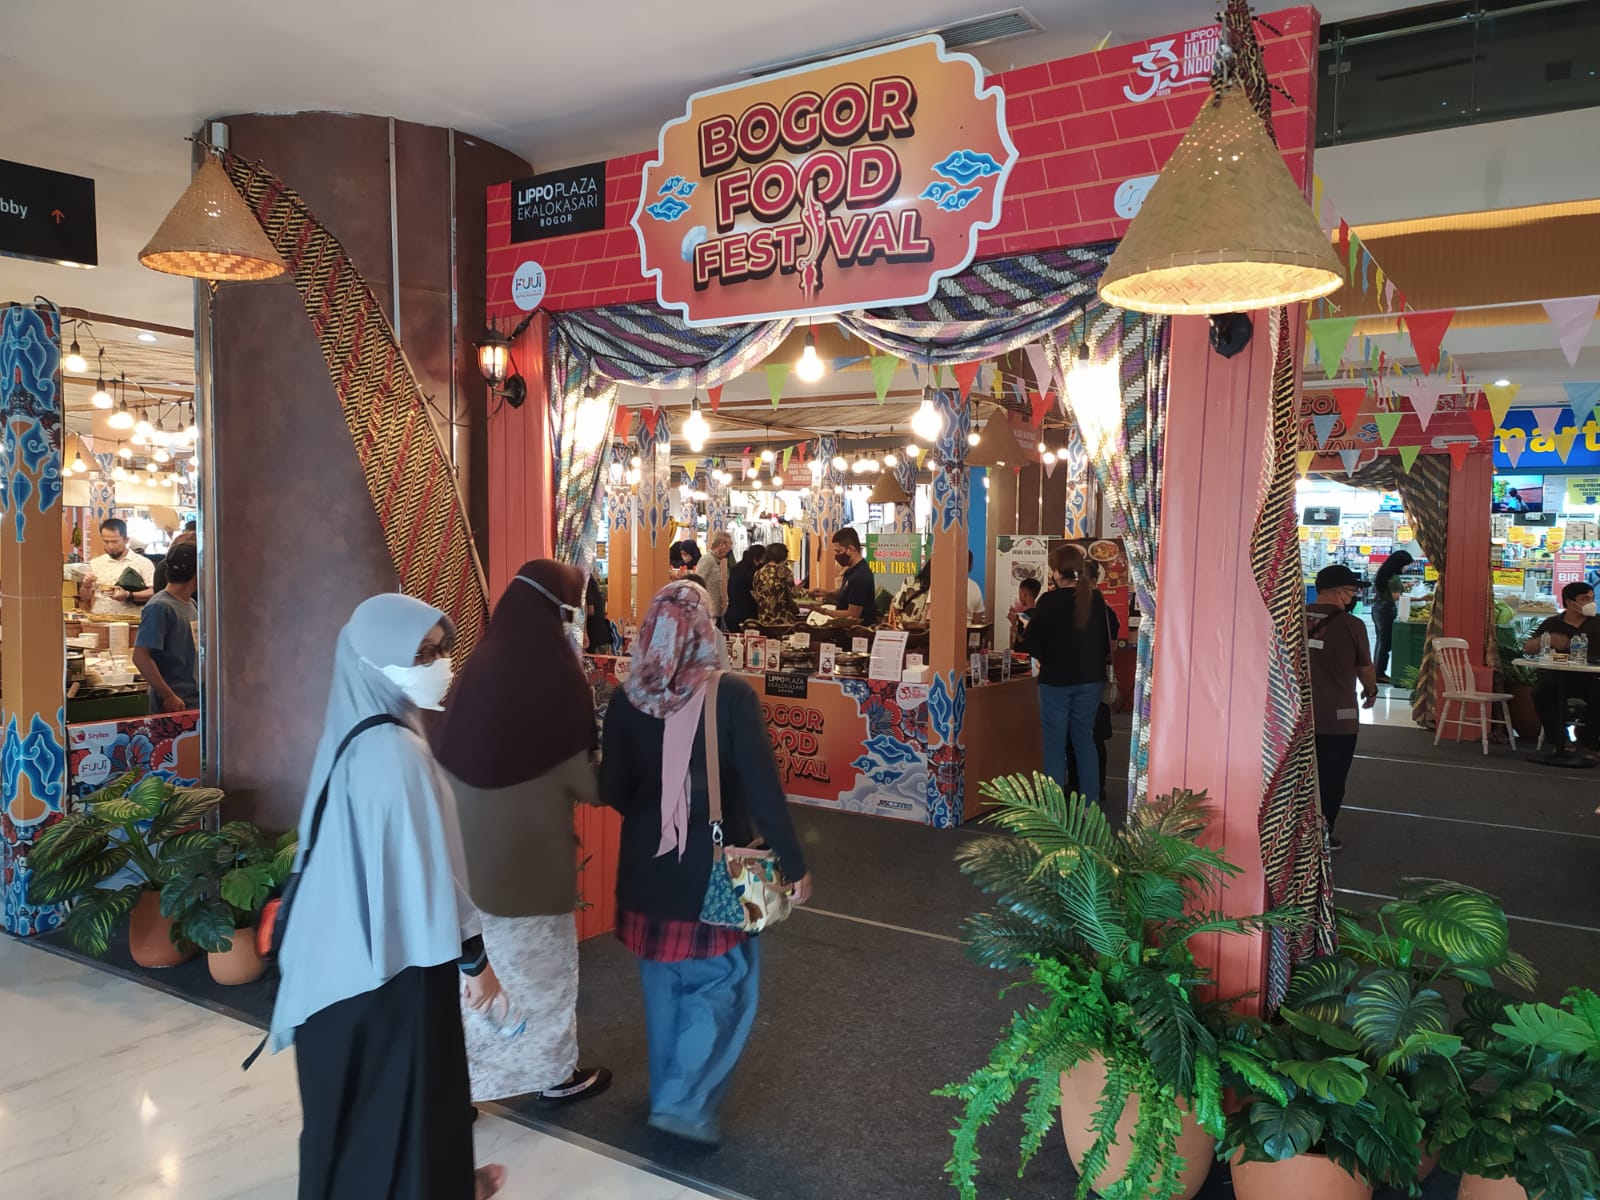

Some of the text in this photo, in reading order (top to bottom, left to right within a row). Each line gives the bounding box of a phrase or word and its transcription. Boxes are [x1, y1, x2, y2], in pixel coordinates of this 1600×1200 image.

[699, 75, 918, 176] BOGOR
[716, 144, 902, 232] FOOD
[517, 194, 599, 221] EKALOKASARI
[540, 213, 573, 227] BOGOR
[890, 560, 917, 575] TIBAN
